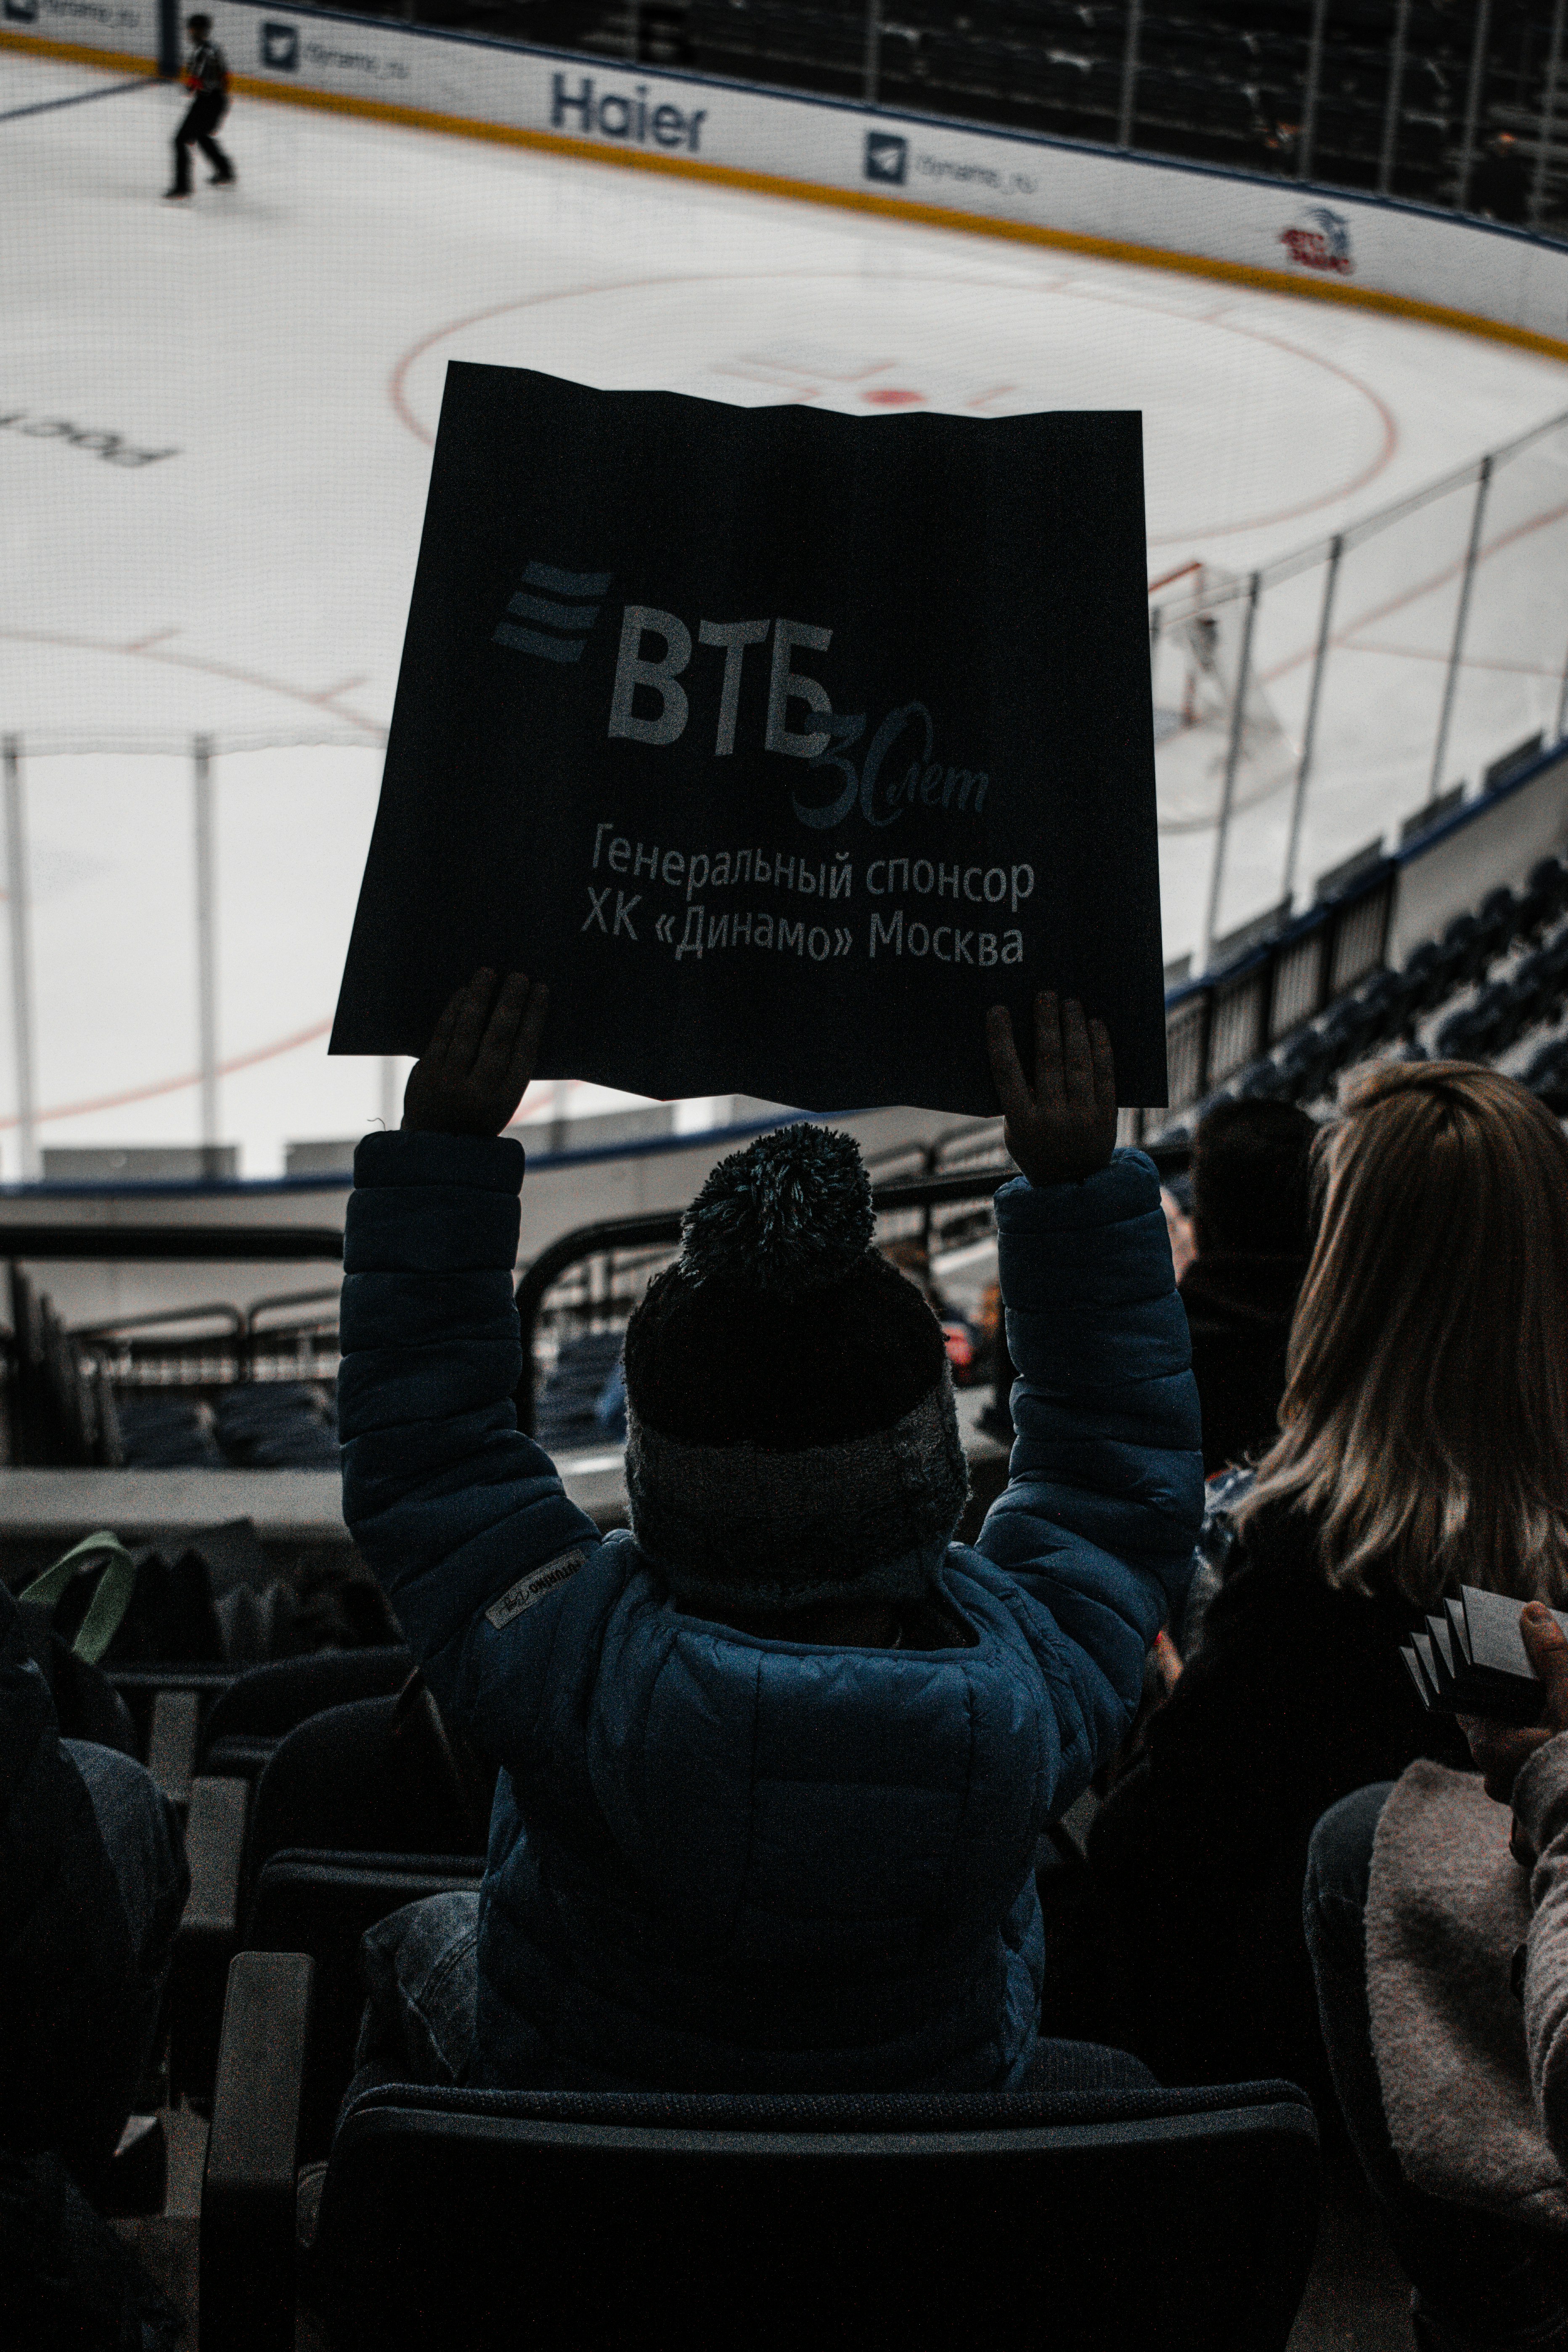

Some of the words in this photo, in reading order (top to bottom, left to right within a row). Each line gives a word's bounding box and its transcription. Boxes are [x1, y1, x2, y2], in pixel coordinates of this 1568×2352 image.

[550, 71, 707, 152] Haier
[608, 605, 833, 758] ВТБ
[792, 700, 933, 829] 30
[885, 762, 989, 813] лет
[593, 823, 853, 901] Генеральный
[866, 858, 1035, 913] спонсор
[582, 887, 642, 940] ХК
[655, 905, 853, 961] «Динамо»
[869, 910, 1024, 966] Москва
